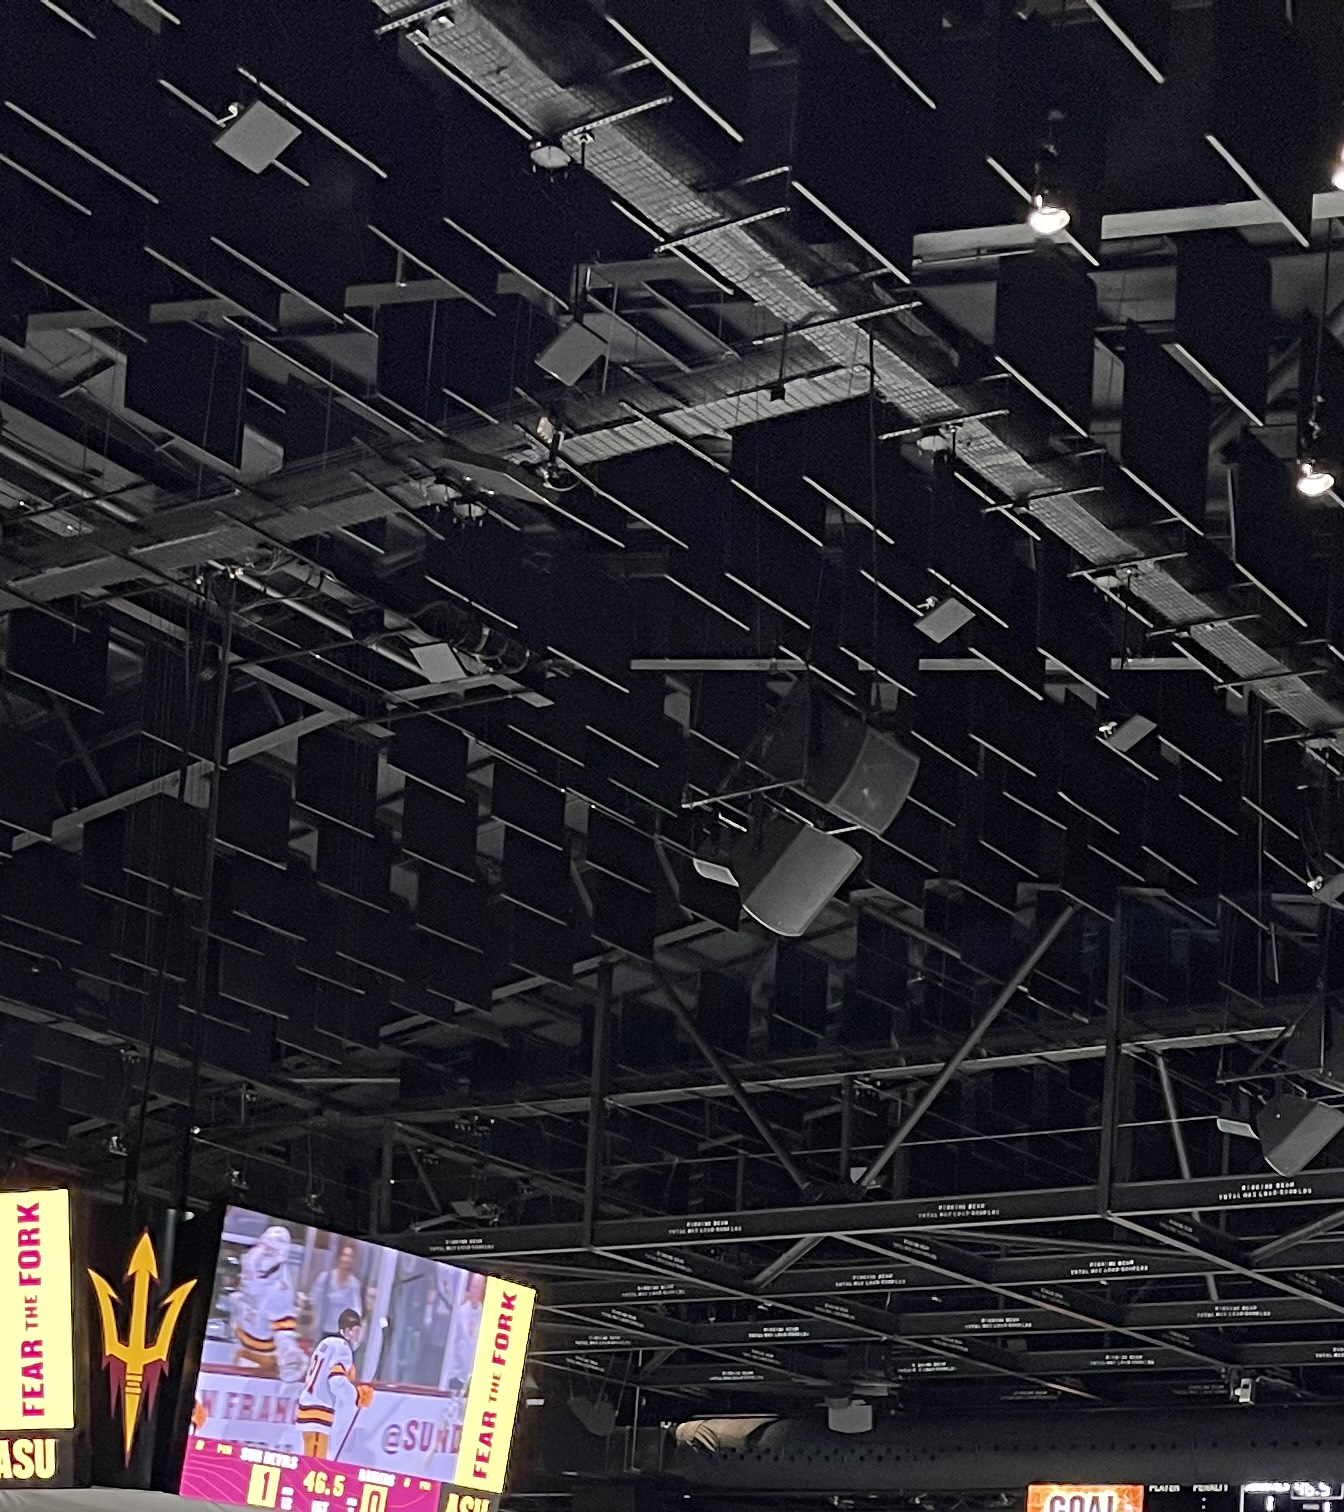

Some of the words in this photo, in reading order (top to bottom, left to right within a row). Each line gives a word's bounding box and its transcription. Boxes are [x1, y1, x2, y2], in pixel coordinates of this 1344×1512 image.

[16, 1201, 41, 1287] FORK
[24, 1295, 39, 1331] THE
[491, 1290, 517, 1366] FORK
[20, 1339, 45, 1417] FEAR
[489, 1372, 502, 1403] THE
[473, 1410, 497, 1479] FEAR
[303, 1470, 345, 1497] 46.5
